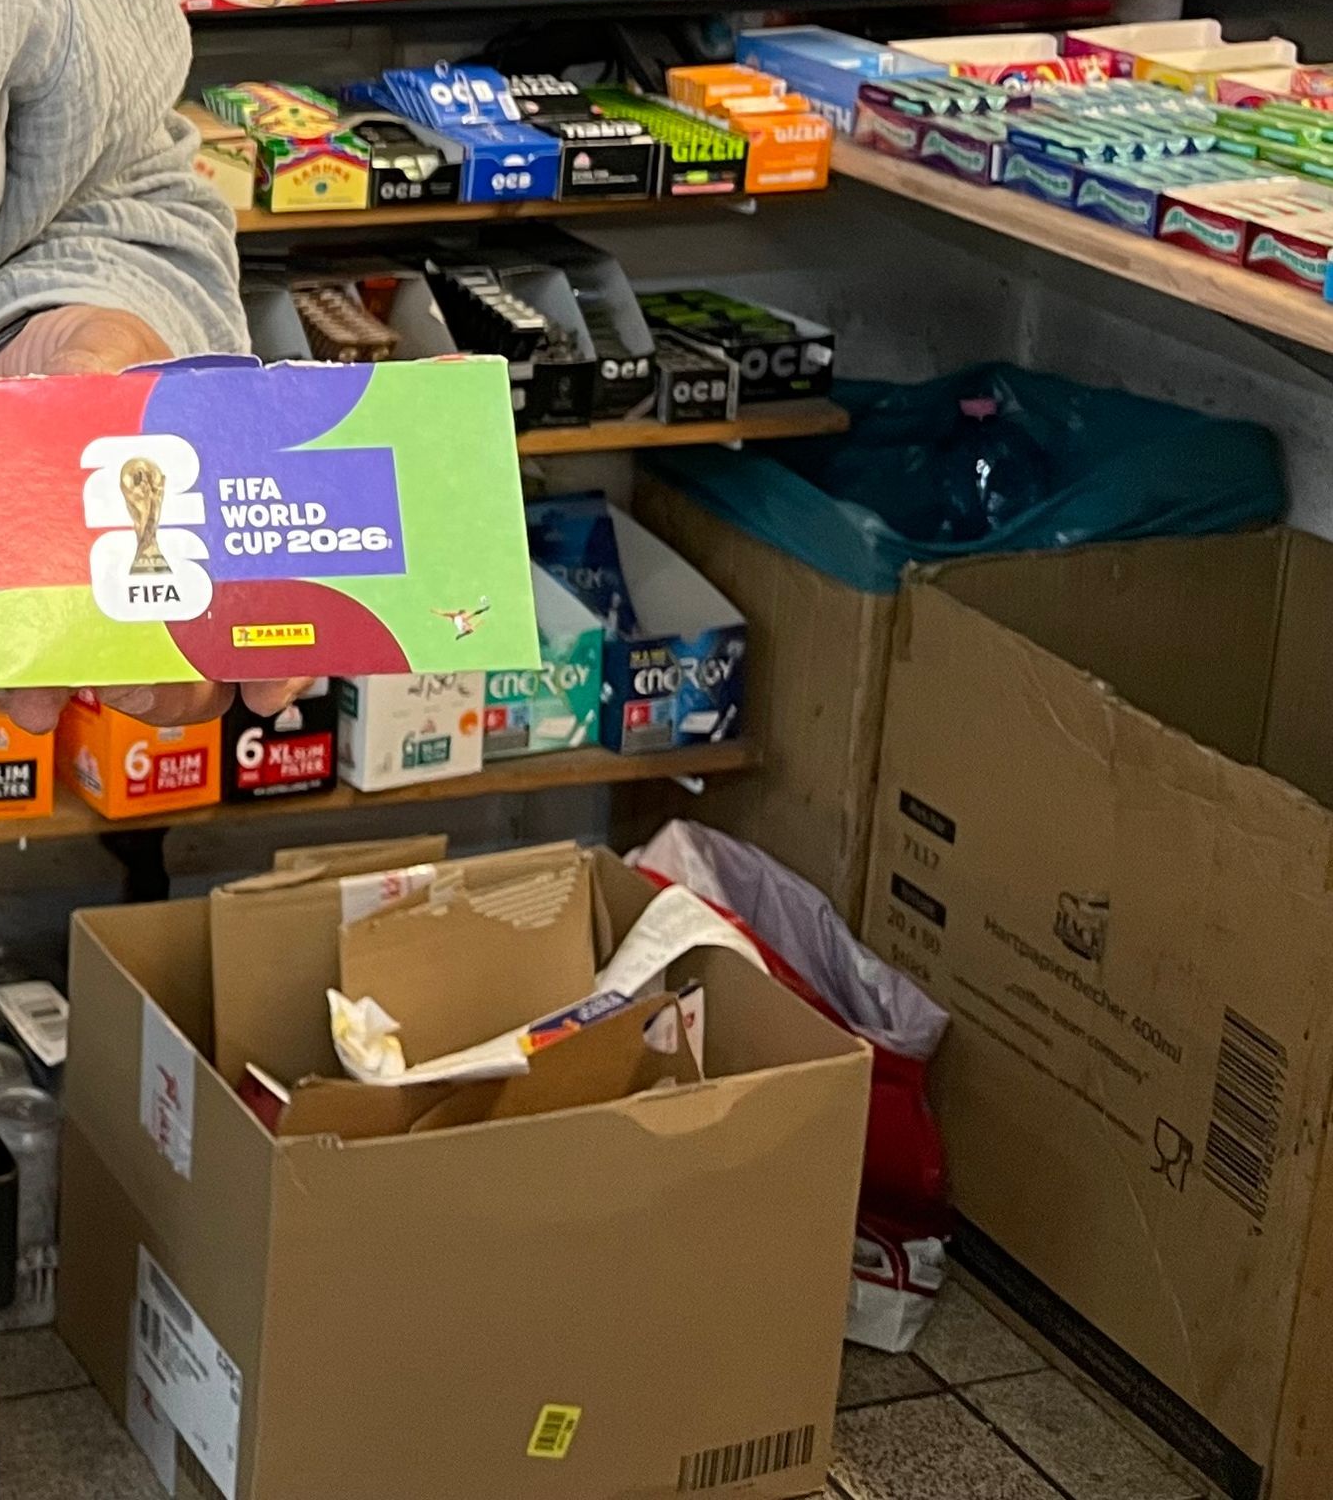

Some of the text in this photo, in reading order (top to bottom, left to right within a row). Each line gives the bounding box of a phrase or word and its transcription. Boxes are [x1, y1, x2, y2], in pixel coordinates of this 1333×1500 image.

[671, 135, 745, 164] GIZEH
[219, 478, 281, 502] FIFA
[224, 503, 326, 528] WORLD
[225, 532, 283, 555] CUP
[128, 584, 181, 605] FIFA
[256, 626, 310, 641] PANINI
[157, 753, 203, 774] SLIM
[157, 772, 202, 790] FILTER
